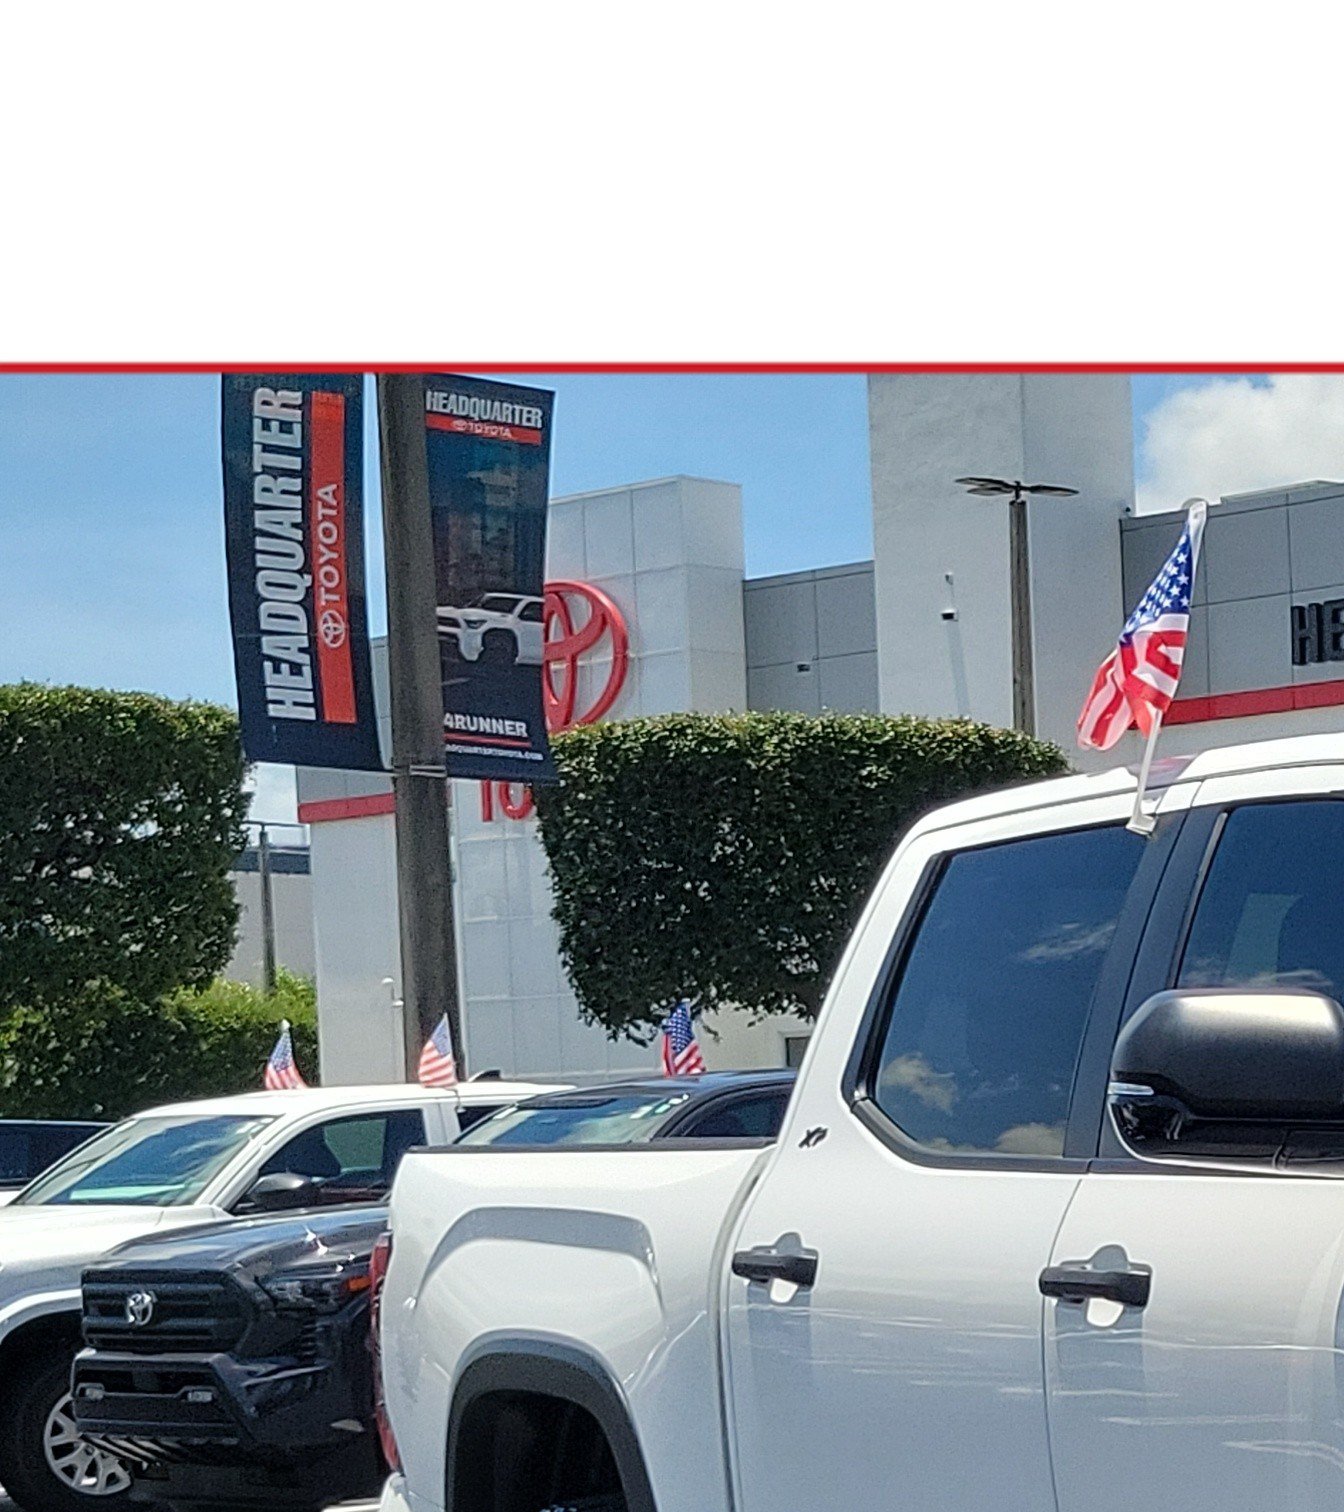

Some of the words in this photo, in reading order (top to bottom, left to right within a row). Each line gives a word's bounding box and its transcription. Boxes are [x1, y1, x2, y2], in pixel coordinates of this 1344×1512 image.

[425, 389, 544, 429] HEADQUARTER
[254, 387, 317, 721] HEADQUARTER
[317, 484, 341, 606] TOYOTA
[443, 712, 528, 738] 4RUNNER
